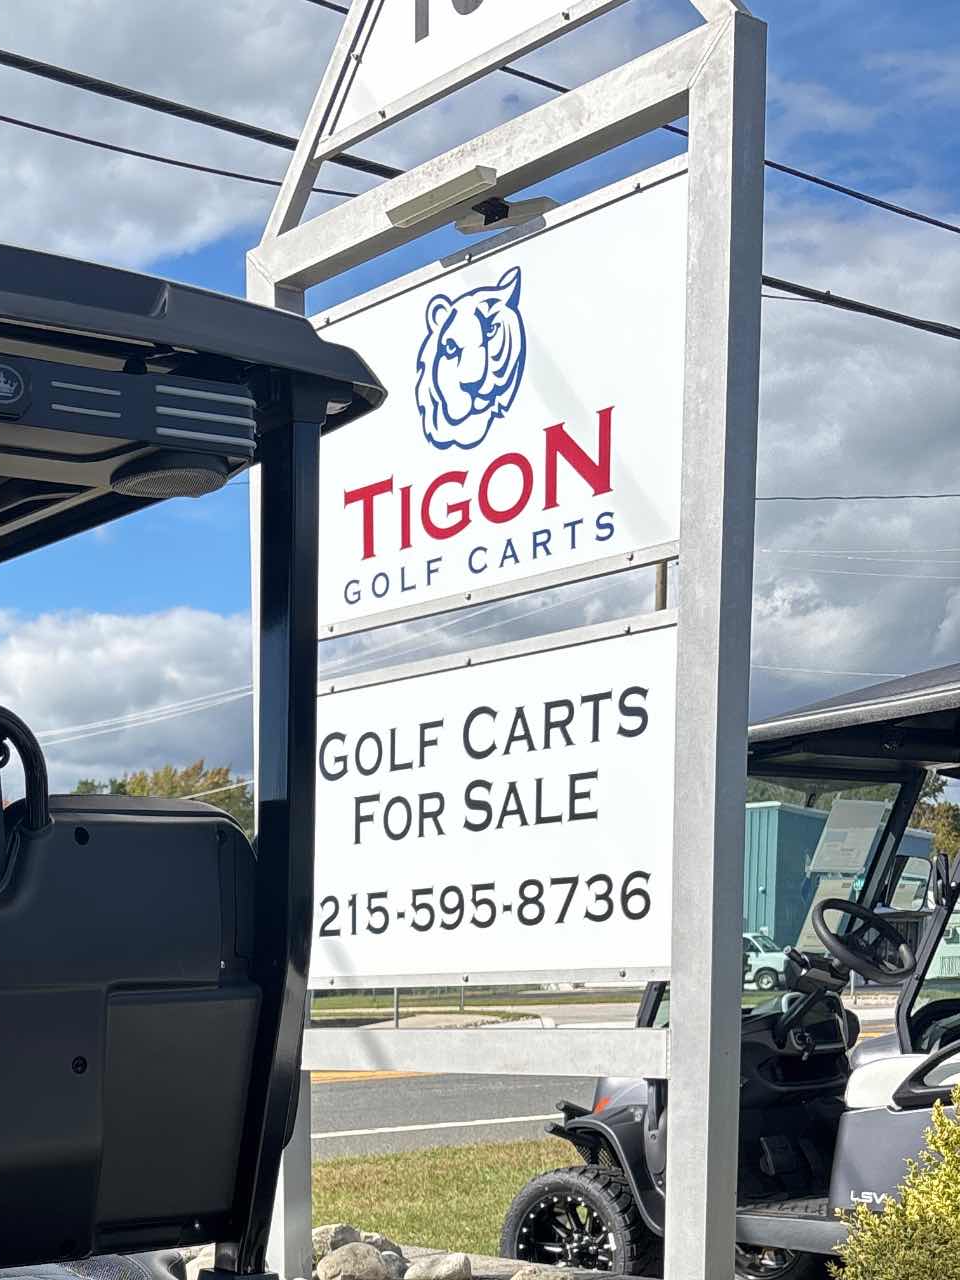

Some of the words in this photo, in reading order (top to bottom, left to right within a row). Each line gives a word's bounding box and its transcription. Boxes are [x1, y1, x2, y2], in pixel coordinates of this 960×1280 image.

[343, 405, 616, 561] TIGON
[343, 557, 443, 605] GOLF
[467, 511, 616, 574] CARTS
[318, 718, 445, 782] GOLF
[462, 685, 650, 760] CARTS
[353, 791, 446, 845] FOR
[462, 768, 600, 833] SALE
[318, 870, 652, 938] 215-595-8736
[849, 1189, 886, 1204] LSV
